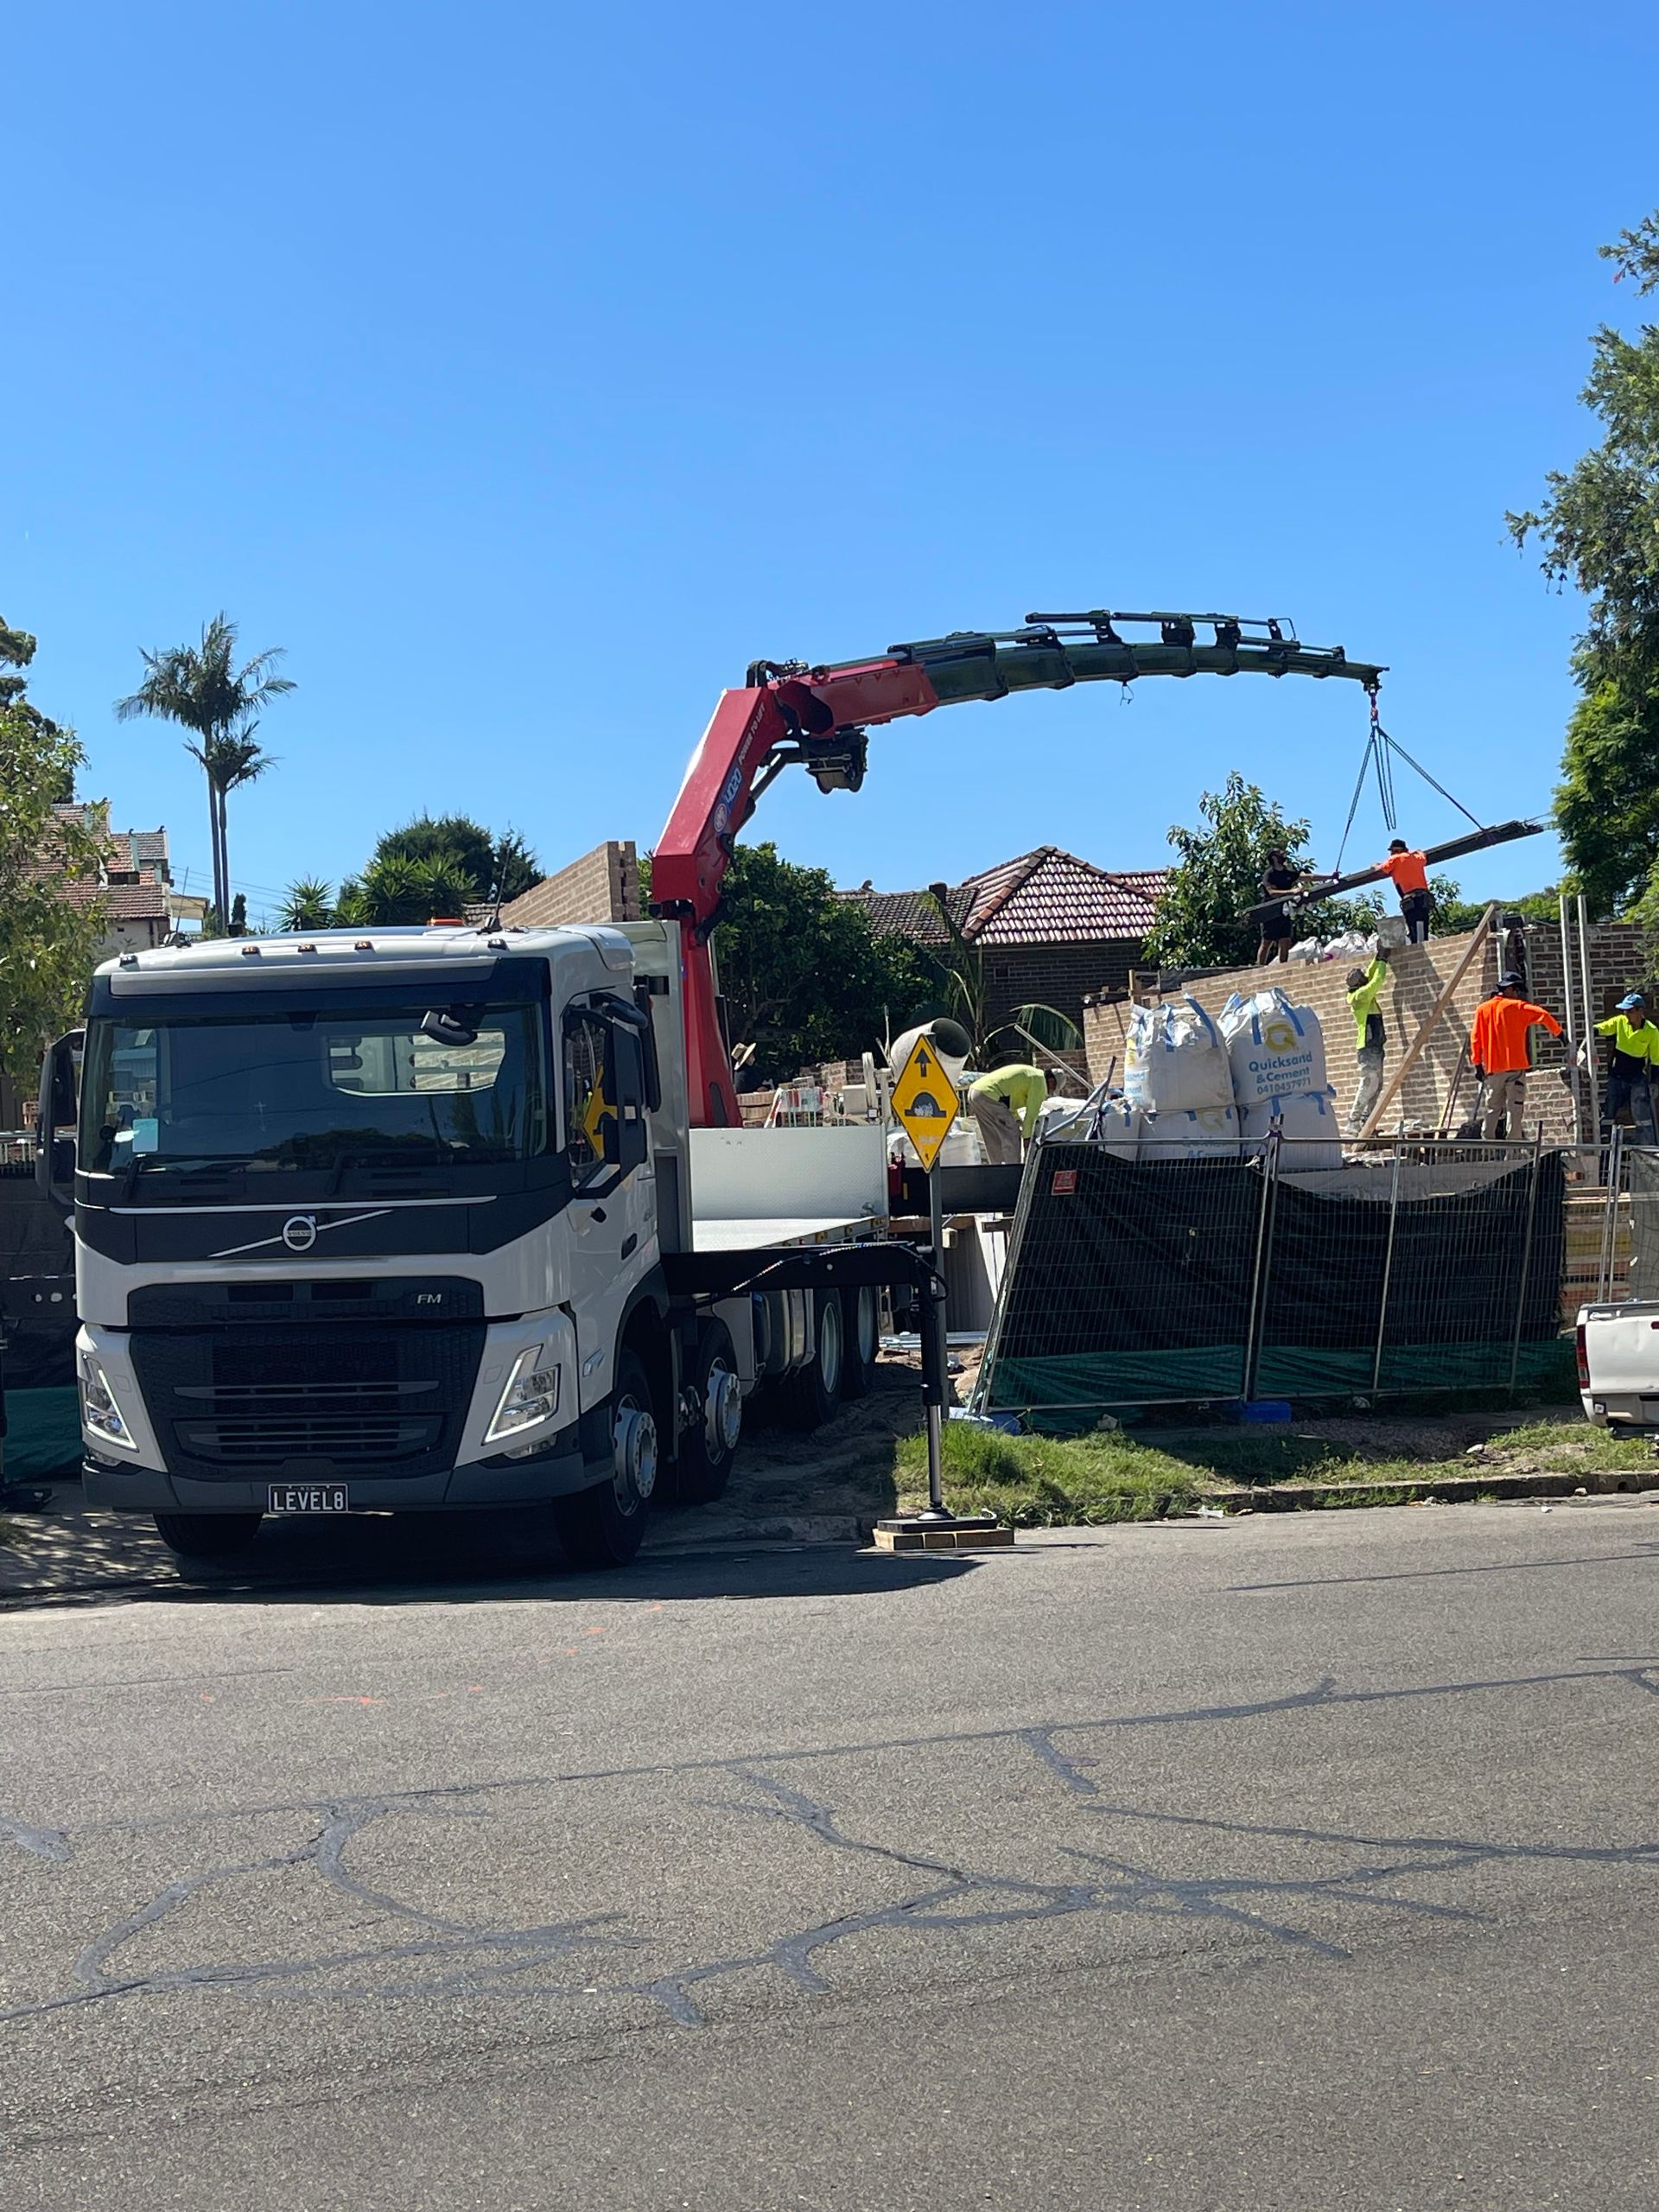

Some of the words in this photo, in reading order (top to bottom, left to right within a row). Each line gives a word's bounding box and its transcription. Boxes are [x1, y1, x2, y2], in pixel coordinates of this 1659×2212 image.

[738, 732, 753, 766] POWER
[751, 720, 758, 734] TO
[755, 701, 766, 723] LIFT
[1249, 1051, 1313, 1072] Quicksand
[1256, 1077, 1312, 1095] 0410457971
[417, 1294, 442, 1304] FM
[274, 1491, 344, 1510] LEVEL8
